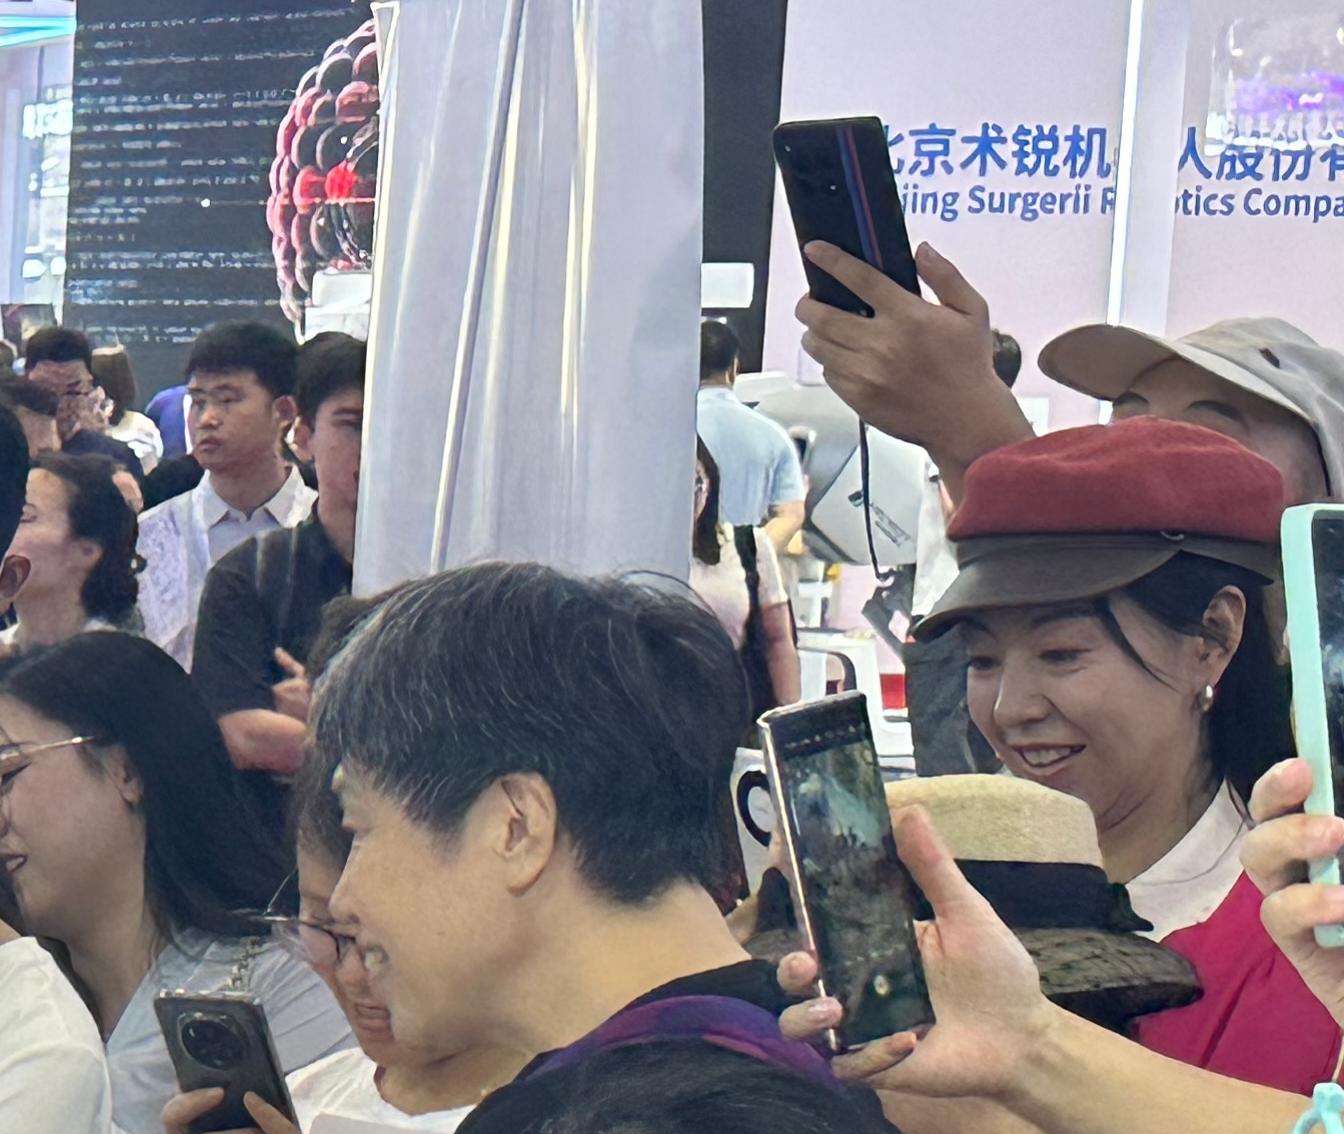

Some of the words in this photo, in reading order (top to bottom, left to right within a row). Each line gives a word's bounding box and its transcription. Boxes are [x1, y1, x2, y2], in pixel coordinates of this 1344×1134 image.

[889, 121, 1344, 181] 京术锐机人股份
[902, 183, 960, 222] jing
[968, 184, 1093, 222] Surgerii
